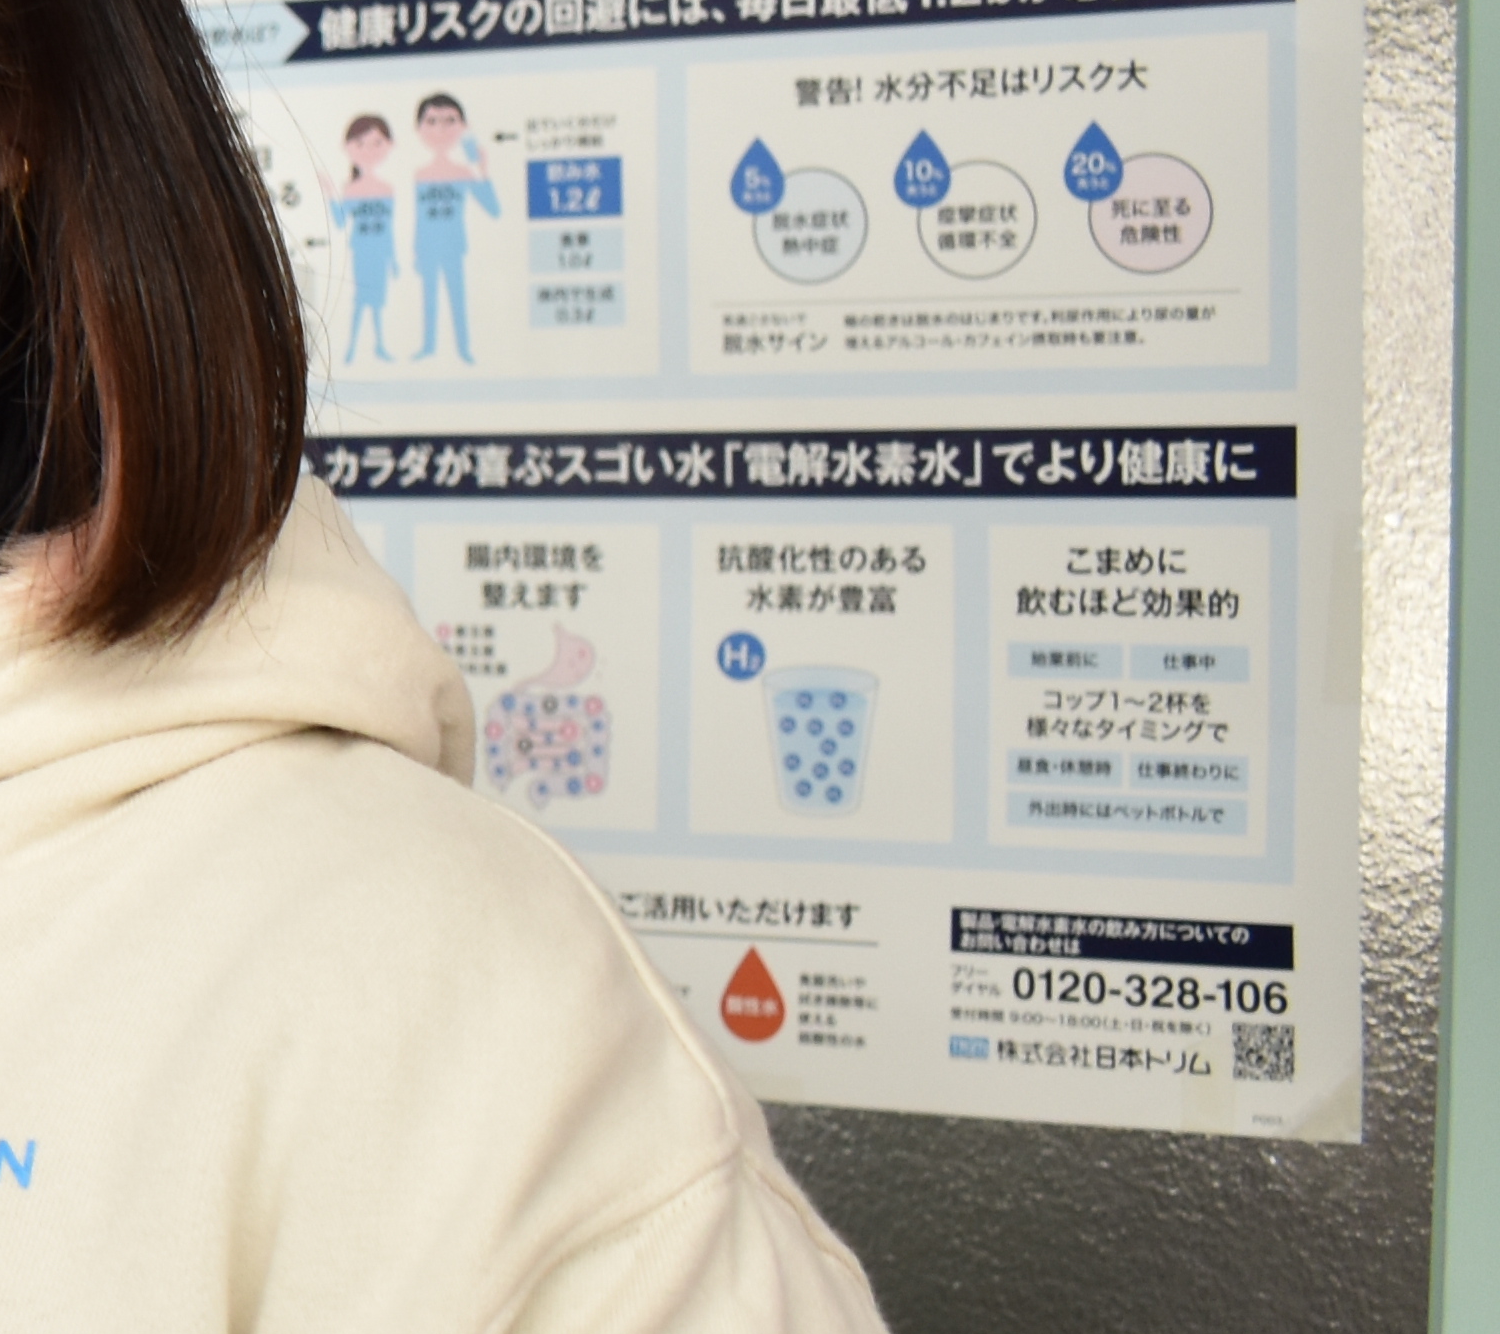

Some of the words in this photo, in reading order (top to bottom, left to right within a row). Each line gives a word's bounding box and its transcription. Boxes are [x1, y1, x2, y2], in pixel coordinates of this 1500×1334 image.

[795, 76, 864, 108] 警告!
[873, 60, 1149, 103] 水分不足はリスク大
[772, 208, 851, 232] 脱水症状
[1111, 196, 1192, 219] 死に至る
[781, 234, 841, 257] 熱中症
[1118, 222, 1183, 246] 危険性
[722, 329, 829, 356] 脱水サイン
[325, 439, 1259, 491] カラダが喜ぶスゴい水「電解水素水」でより健康に
[464, 543, 605, 572] 腸内環境を
[716, 542, 928, 575] 抗酸化性のある
[1064, 546, 1188, 577] こまめに
[481, 581, 589, 611] 整えます
[746, 584, 898, 615] 水素が豊富
[1015, 587, 1241, 620] 飲むほど効果的
[1162, 652, 1218, 673] 仕事中
[1026, 716, 1230, 745] 様々なタイミングで
[1136, 760, 1241, 784] 仕事終わりに
[1026, 799, 1227, 827] 外出時にはペットボトルで
[617, 889, 862, 930] ご活用いただけます
[958, 932, 1084, 958] お問い合わせは
[950, 963, 990, 978] フリー
[950, 978, 1002, 999] ダイヤル
[1011, 966, 1290, 1016] 0120-328-106
[996, 1037, 1212, 1078] 株式会社日本トリム
